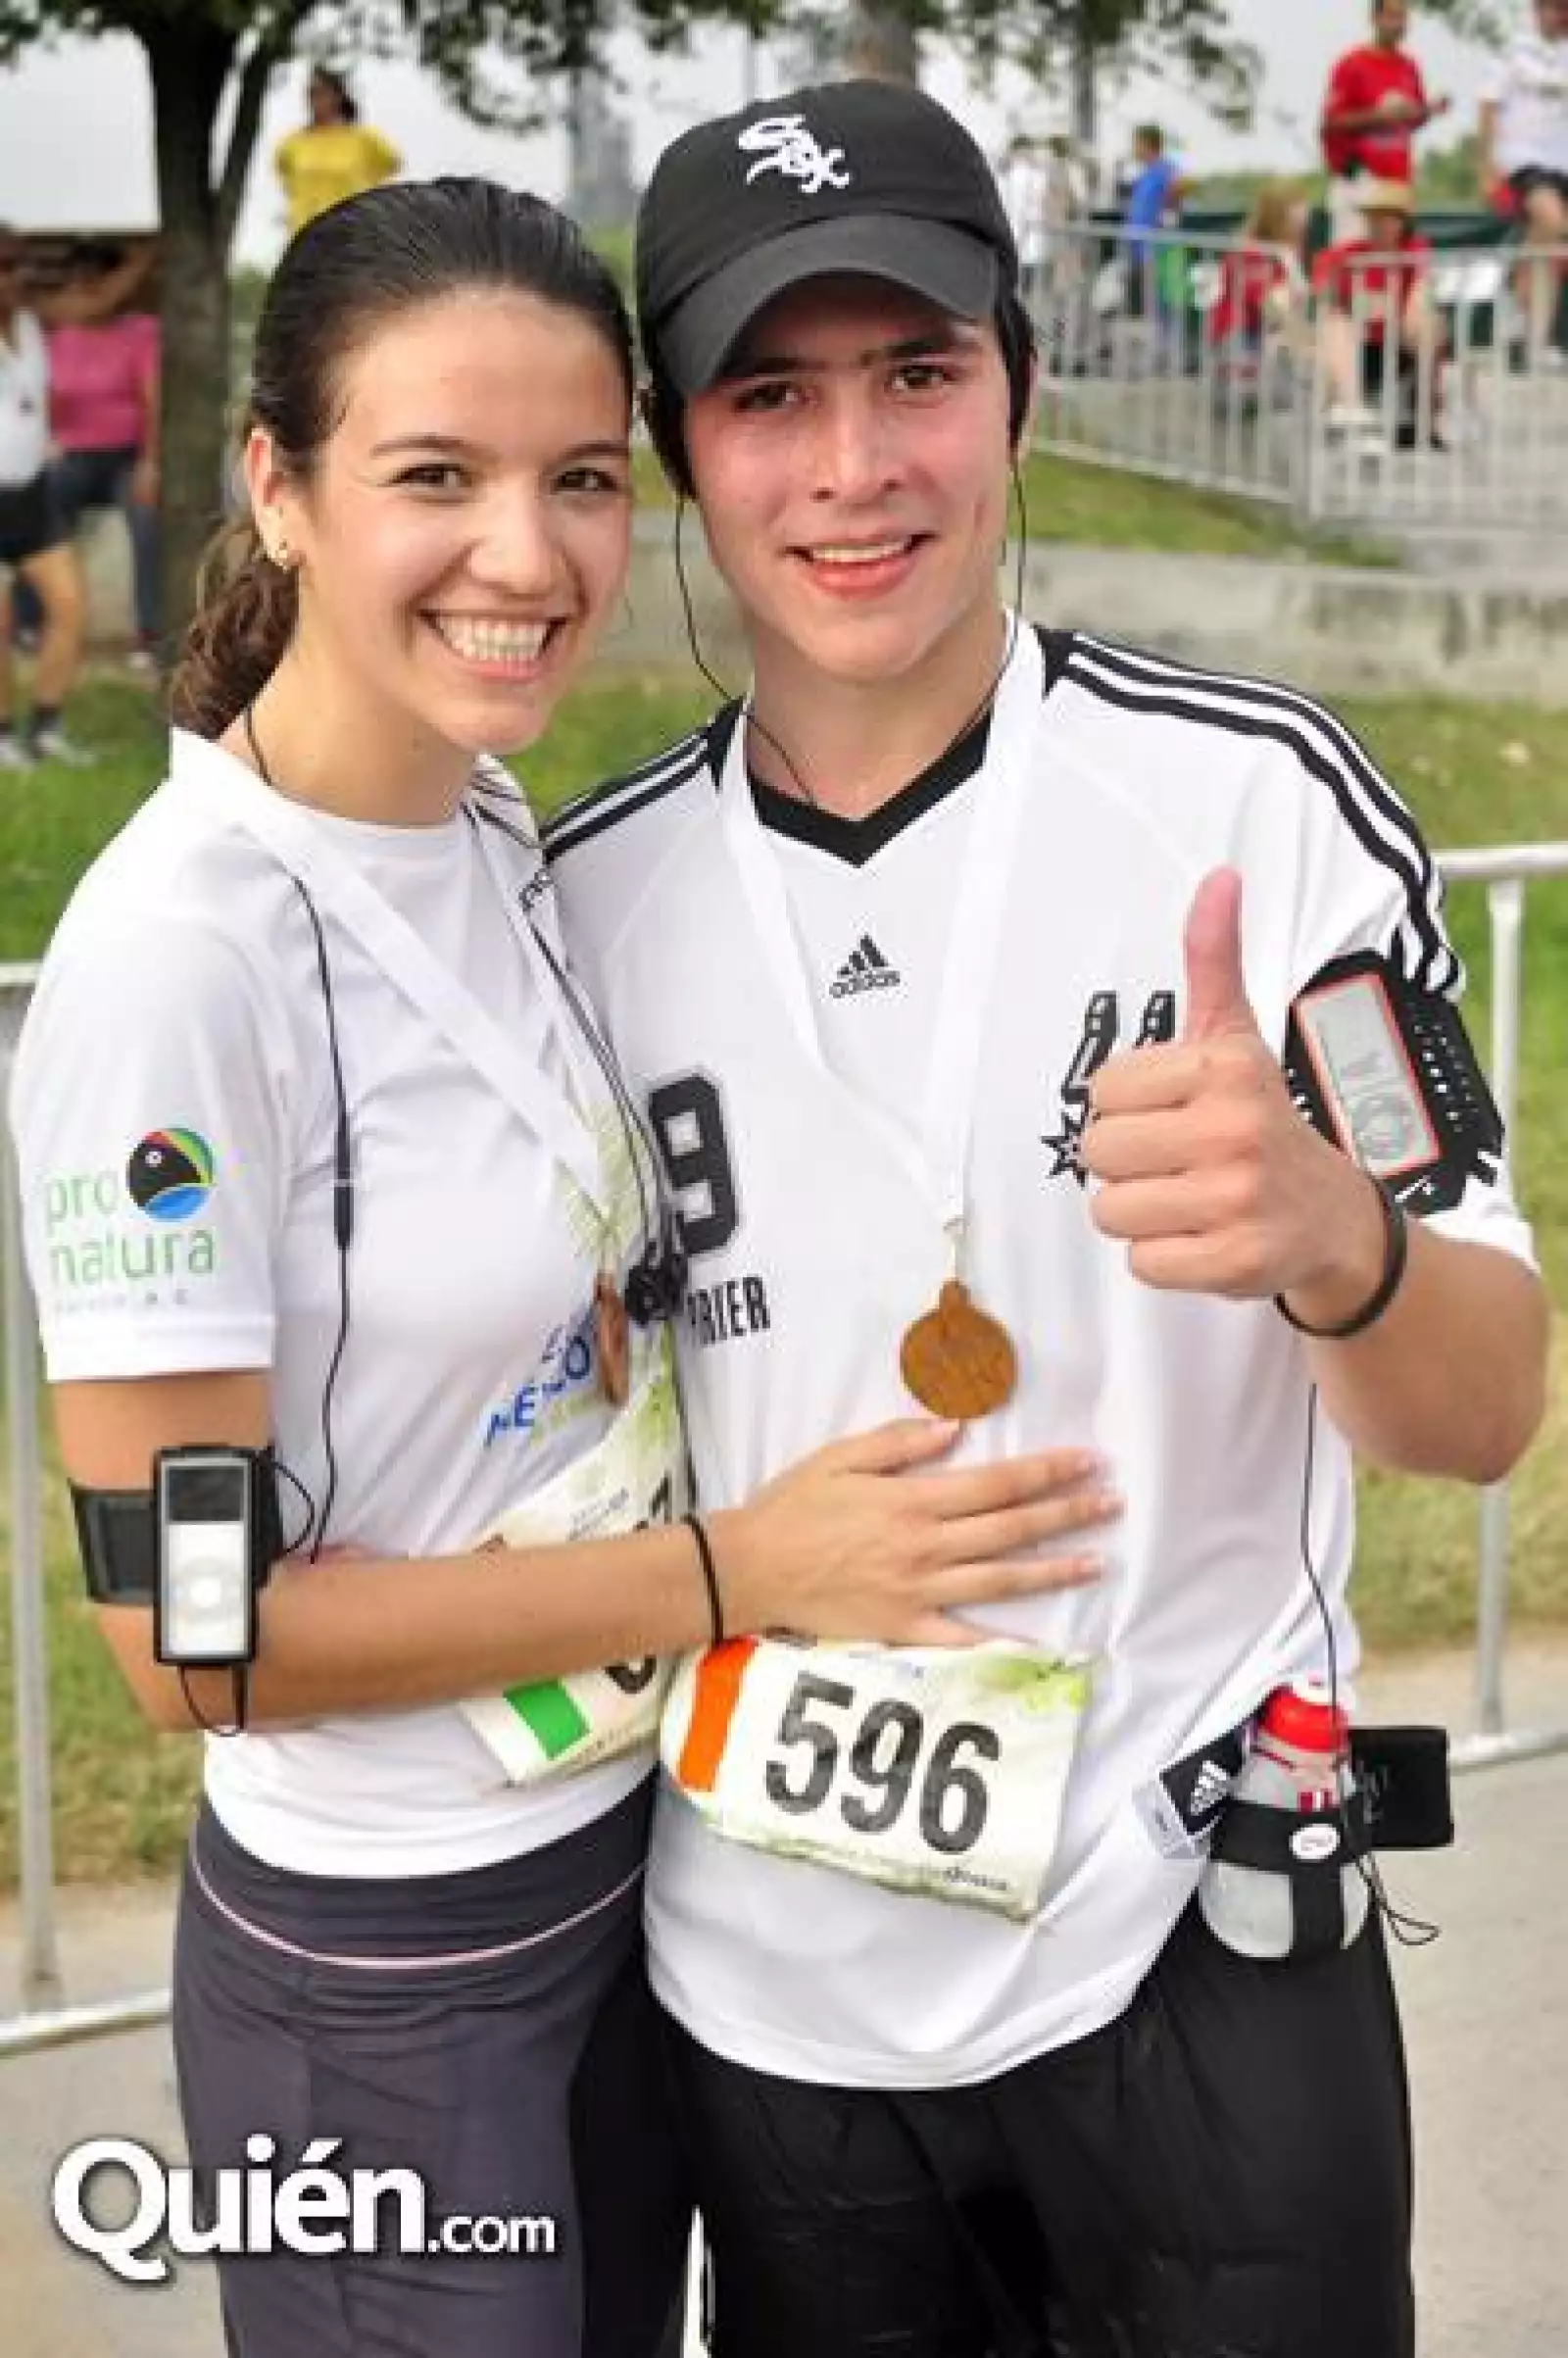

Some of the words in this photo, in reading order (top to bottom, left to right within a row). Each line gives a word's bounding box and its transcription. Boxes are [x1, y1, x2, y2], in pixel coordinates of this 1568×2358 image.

[45, 1169, 119, 1238] pro
[648, 1072, 741, 1253] 9
[50, 1228, 214, 1288] natura
[764, 1670, 1001, 1855] 596
